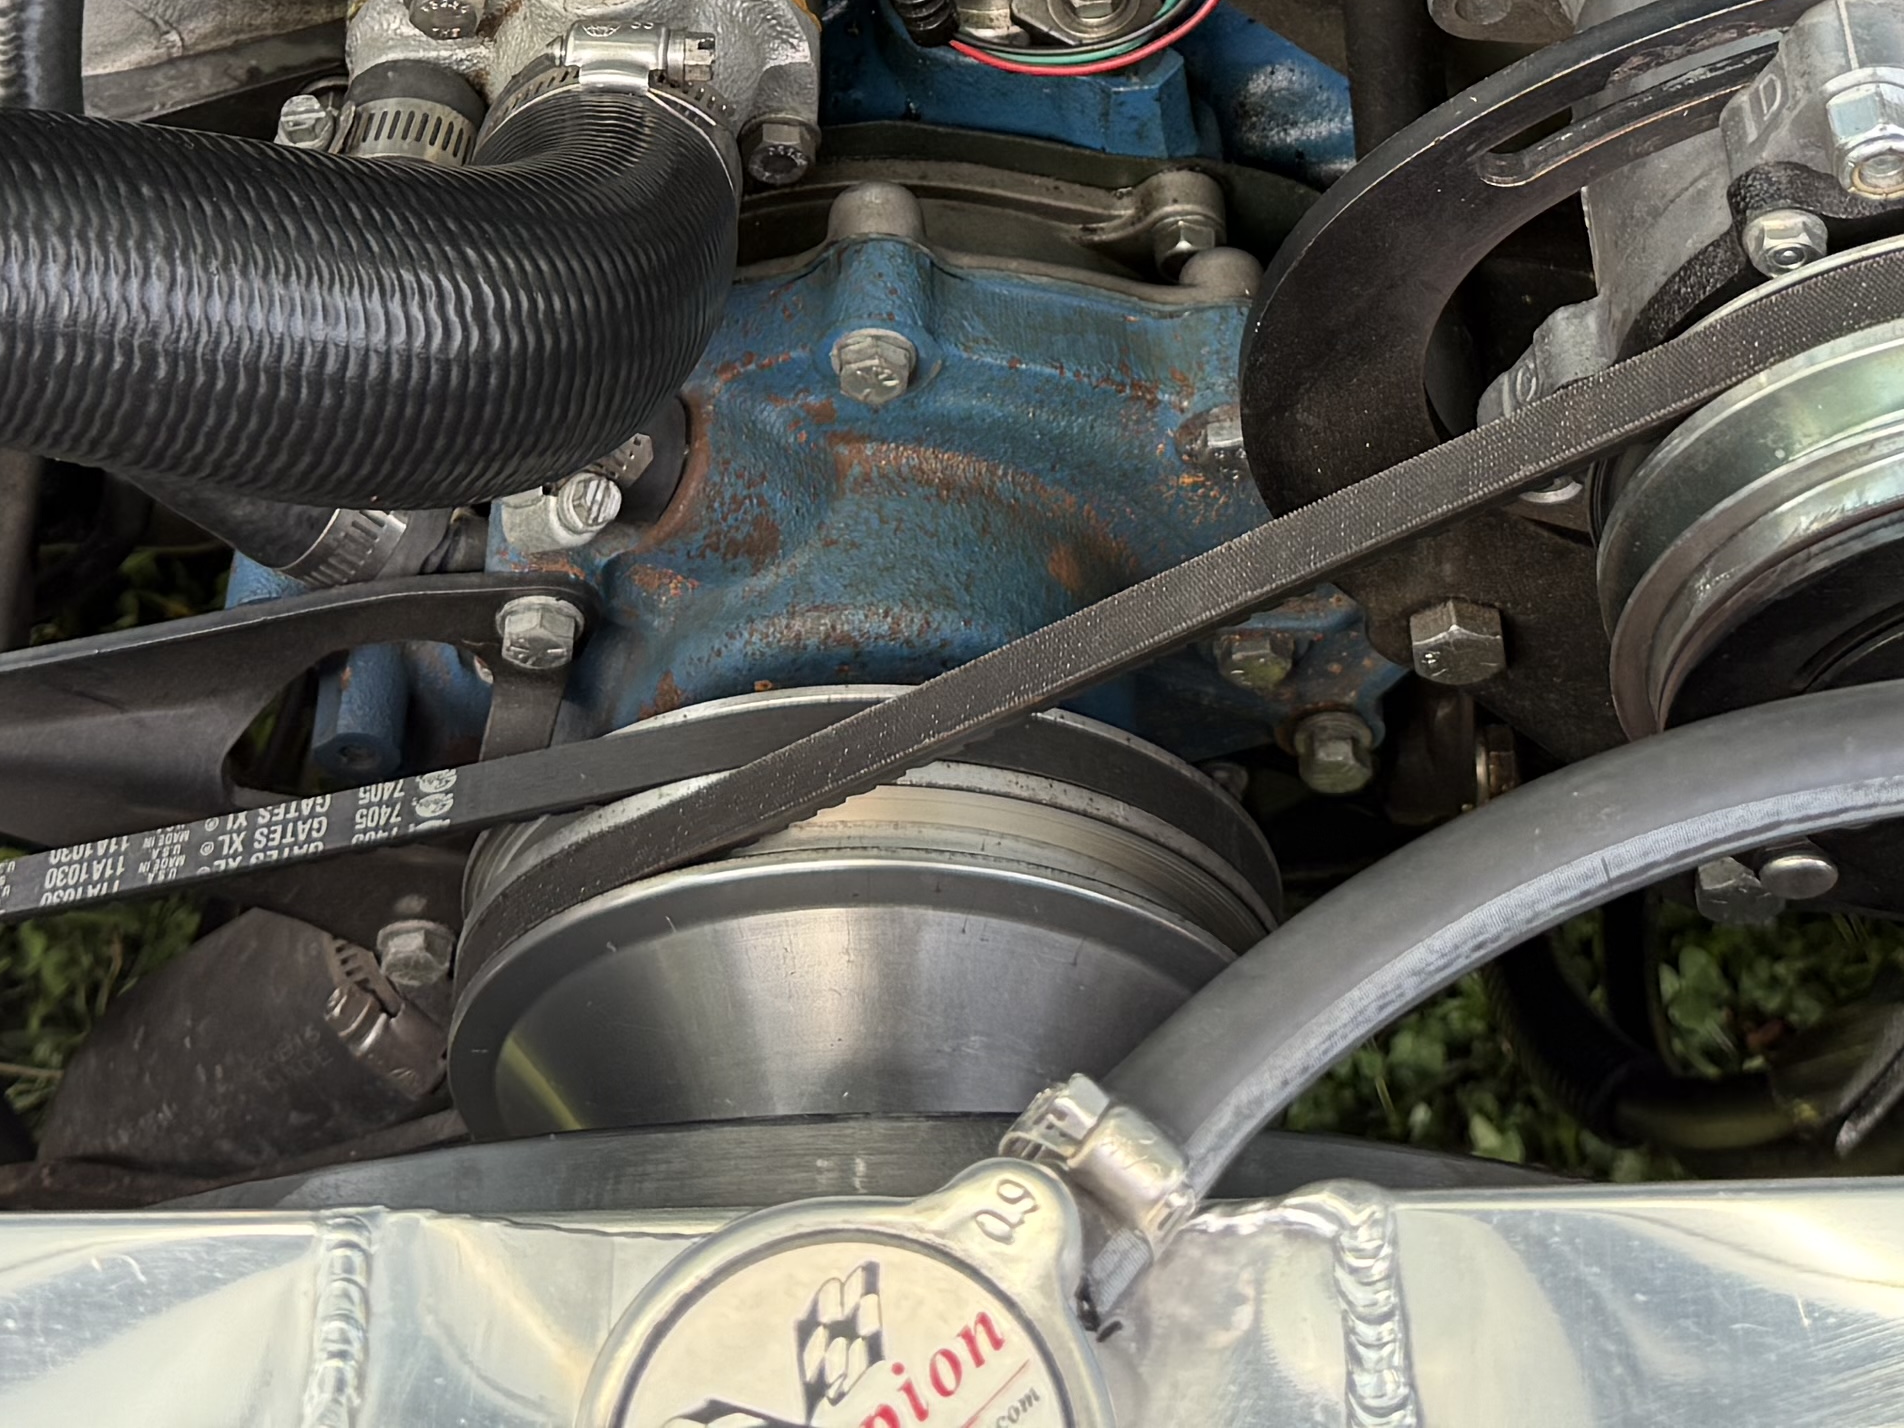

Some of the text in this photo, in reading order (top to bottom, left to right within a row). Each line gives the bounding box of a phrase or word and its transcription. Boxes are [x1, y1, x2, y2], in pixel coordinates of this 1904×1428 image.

[354, 800, 403, 830] 7405
[156, 829, 191, 845] MADE
[252, 815, 328, 850] GATES
[44, 853, 126, 889] 11A1030
[151, 853, 187, 871] MADE
